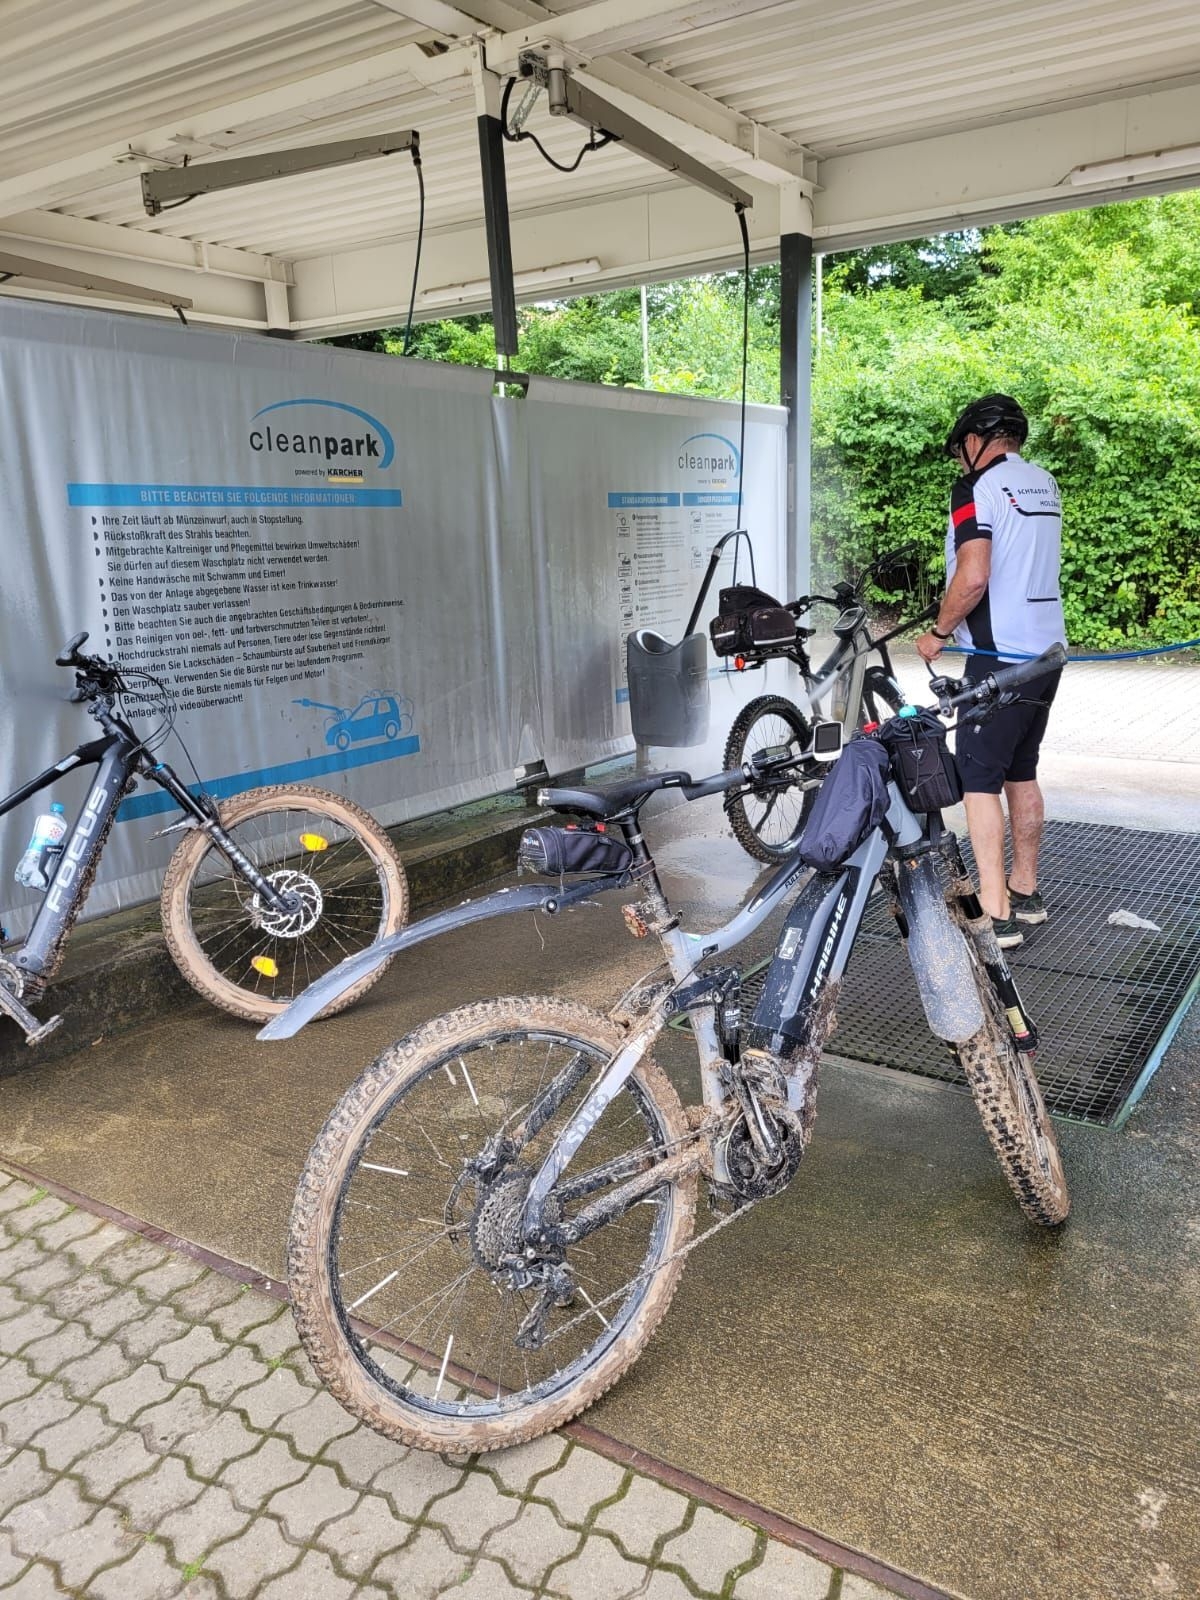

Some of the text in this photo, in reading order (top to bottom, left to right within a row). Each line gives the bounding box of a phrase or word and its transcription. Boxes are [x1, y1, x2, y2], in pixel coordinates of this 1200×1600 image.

[249, 426, 380, 459] cleanpark
[294, 469, 318, 477] powered
[318, 469, 325, 477] by
[678, 452, 735, 472] cleanpark
[140, 490, 170, 502] BITTE
[173, 491, 224, 502] BEACHTEN
[226, 492, 241, 502] SIE
[244, 492, 289, 503] FOLGENDE
[102, 515, 304, 526] Ihre Zeit läuft ab Münzeinwurf, auch in Stopstellung.
[103, 529, 252, 541] Rückstoßkraft des Strahls beachten.
[105, 545, 164, 558] Mitgebrachte
[166, 544, 212, 555] Kaltreiniger
[214, 543, 229, 553] und
[231, 542, 274, 554] Pflegemittel
[275, 541, 306, 551] bewirken
[107, 554, 330, 572] Sie dürfen auf diesem Waschplatz nicht verwendet werden.
[109, 569, 286, 587] Keine Handwäsche mit Schwamm und Eimer!
[111, 579, 338, 602] Das von der Anlage abgegebene Wasser ist kein Trinkwasser!
[112, 598, 251, 617] Den Waschplatz sauber verlassen!
[114, 621, 135, 632] Bitte
[138, 618, 177, 629] beachten
[179, 617, 192, 626] Sie
[194, 615, 213, 625] auch
[215, 614, 227, 623] die
[229, 610, 278, 623] angebrachten
[279, 603, 352, 618] Geschäftsbedingungen
[353, 602, 358, 610] &
[116, 637, 133, 647] Das
[135, 634, 173, 645] Reinigen
[175, 632, 190, 641] von
[192, 630, 210, 640] oel-,
[211, 627, 228, 637] fett-
[230, 626, 244, 636] und
[245, 620, 310, 634] farbverschmutzten
[311, 617, 330, 627] Teilen
[331, 617, 340, 626] ist
[118, 645, 189, 661] Hochdruckstrahl
[191, 642, 221, 653] niemals
[223, 640, 236, 650] auf
[237, 637, 272, 648] Personen,
[274, 635, 291, 645] Tiere
[293, 633, 308, 642] oder
[309, 632, 322, 640] lose
[323, 628, 363, 639] Gegenstände
[121, 662, 166, 675] Vermeiden
[168, 660, 181, 670] Sie
[183, 656, 235, 669] Lackschäden
[242, 647, 293, 661] Schaumbürste
[294, 646, 306, 655] auf
[306, 642, 340, 654] Sauberkeit
[342, 641, 354, 649] und
[127, 652, 364, 689] berprüfen. Verwenden Sie die Bürste nur bei laufendem Programm.
[123, 668, 325, 705] Benutzen Sie die Bürste niemals für Felgen und Motor!
[127, 706, 157, 719] Anlage
[180, 692, 243, 711] videoüberwacht!
[47, 786, 108, 913] FOCUS
[810, 892, 848, 999] HAIBIKE
